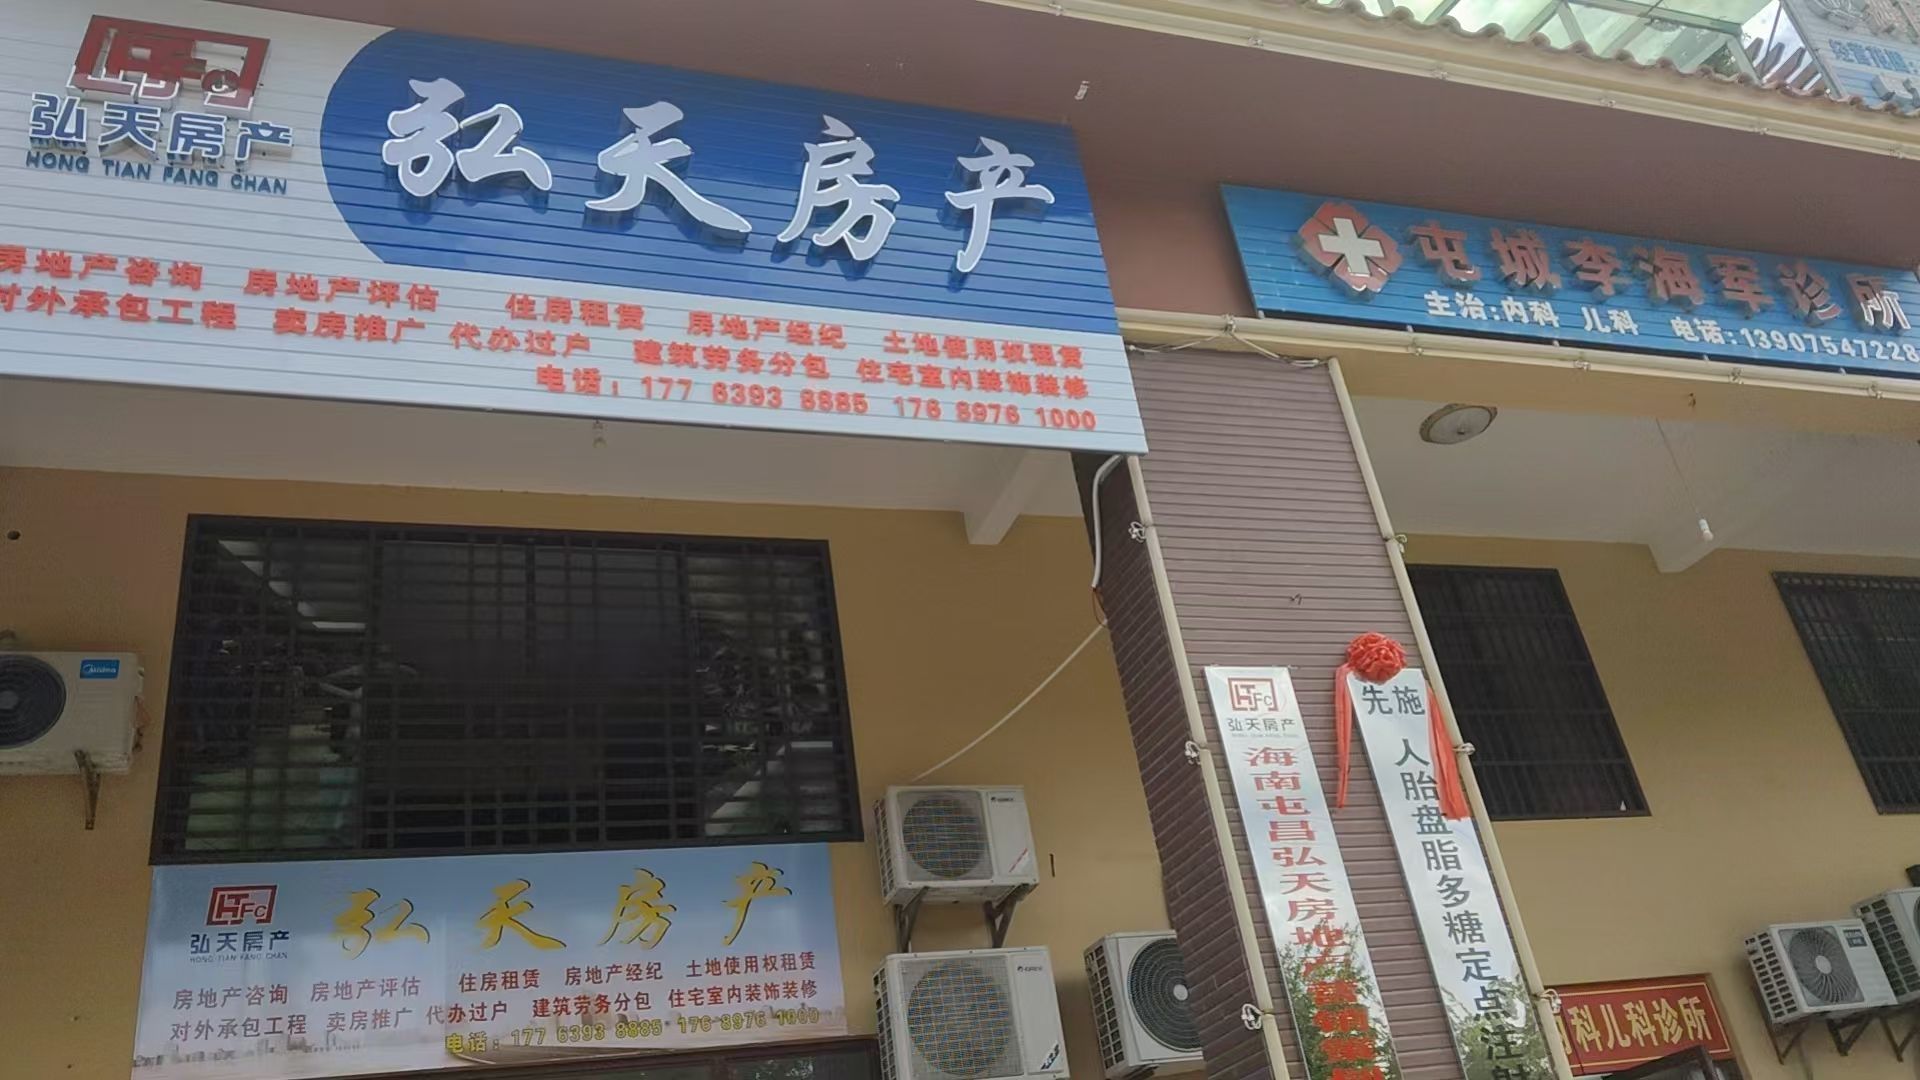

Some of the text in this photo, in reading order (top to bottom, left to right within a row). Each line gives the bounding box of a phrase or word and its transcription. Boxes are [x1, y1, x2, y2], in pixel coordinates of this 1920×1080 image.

[28, 93, 292, 161] 弘天房产
[26, 151, 288, 195] HONG TIAN FANG CHAN
[382, 78, 1055, 272] 弘天房产
[1409, 220, 1911, 331] 屯城李海军诊所
[0, 245, 1083, 369] 房地产咨询 房地产评估 住房租赁 房地产经纪 土地使用权租赁
[1581, 306, 1639, 336] 儿科
[274, 307, 425, 343] 卖房推广
[449, 322, 591, 357] 代办过户
[633, 339, 829, 379] 建筑劳务分包
[857, 358, 1089, 399] 住宅室内装饰装修
[641, 376, 692, 400] 177
[712, 381, 783, 409] 6393
[800, 389, 869, 413] 8885
[1035, 407, 1097, 431] 1000
[1227, 717, 1296, 732] 弘天房产
[1362, 684, 1426, 716] 先施
[331, 861, 793, 961] 弘天房产
[190, 930, 290, 954] 弘天房产
[173, 951, 816, 1010] 房地产咨询 房地产评估 住房租赁 房地产经纪 土地使用权租赁
[169, 979, 818, 1042] 对外承包工程 卖房推广 代办过户 建筑劳务分包 住宅室内装饰装修
[511, 1028, 546, 1047] 177
[557, 1023, 606, 1044] 6393
[615, 1017, 663, 1039] 8885
